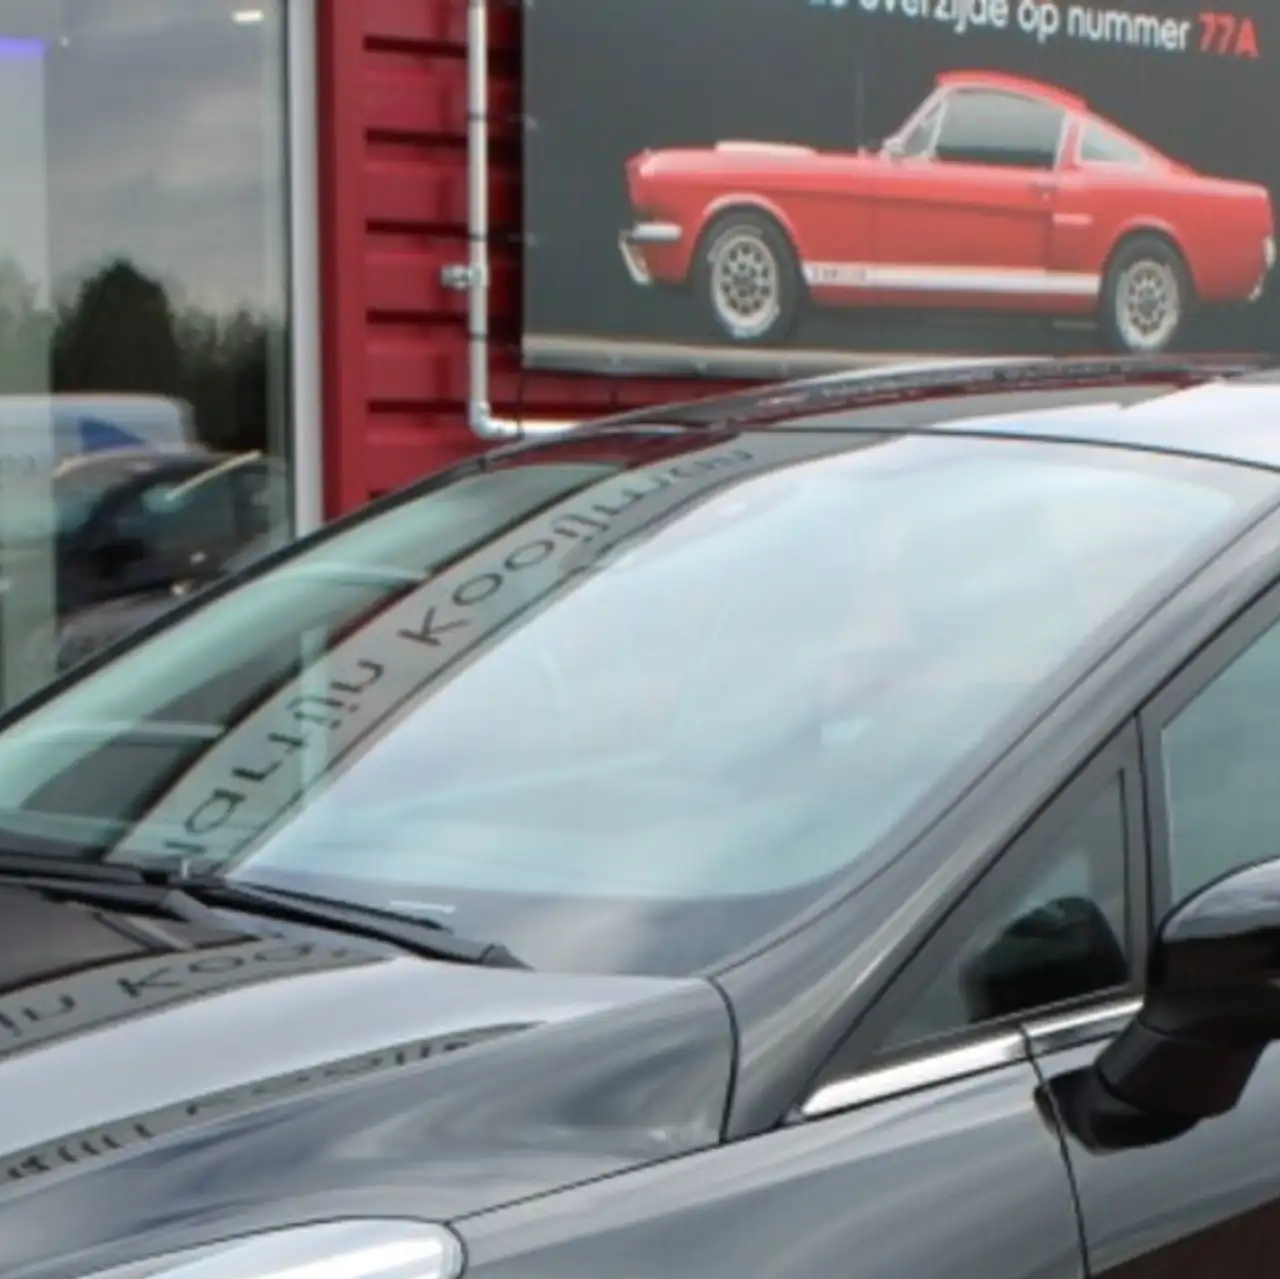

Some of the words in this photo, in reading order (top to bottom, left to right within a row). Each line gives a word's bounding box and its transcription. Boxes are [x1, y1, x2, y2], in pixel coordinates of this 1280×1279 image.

[1018, 7, 1059, 43] op
[1067, 18, 1191, 52] nummer
[1198, 12, 1259, 58] 77A
